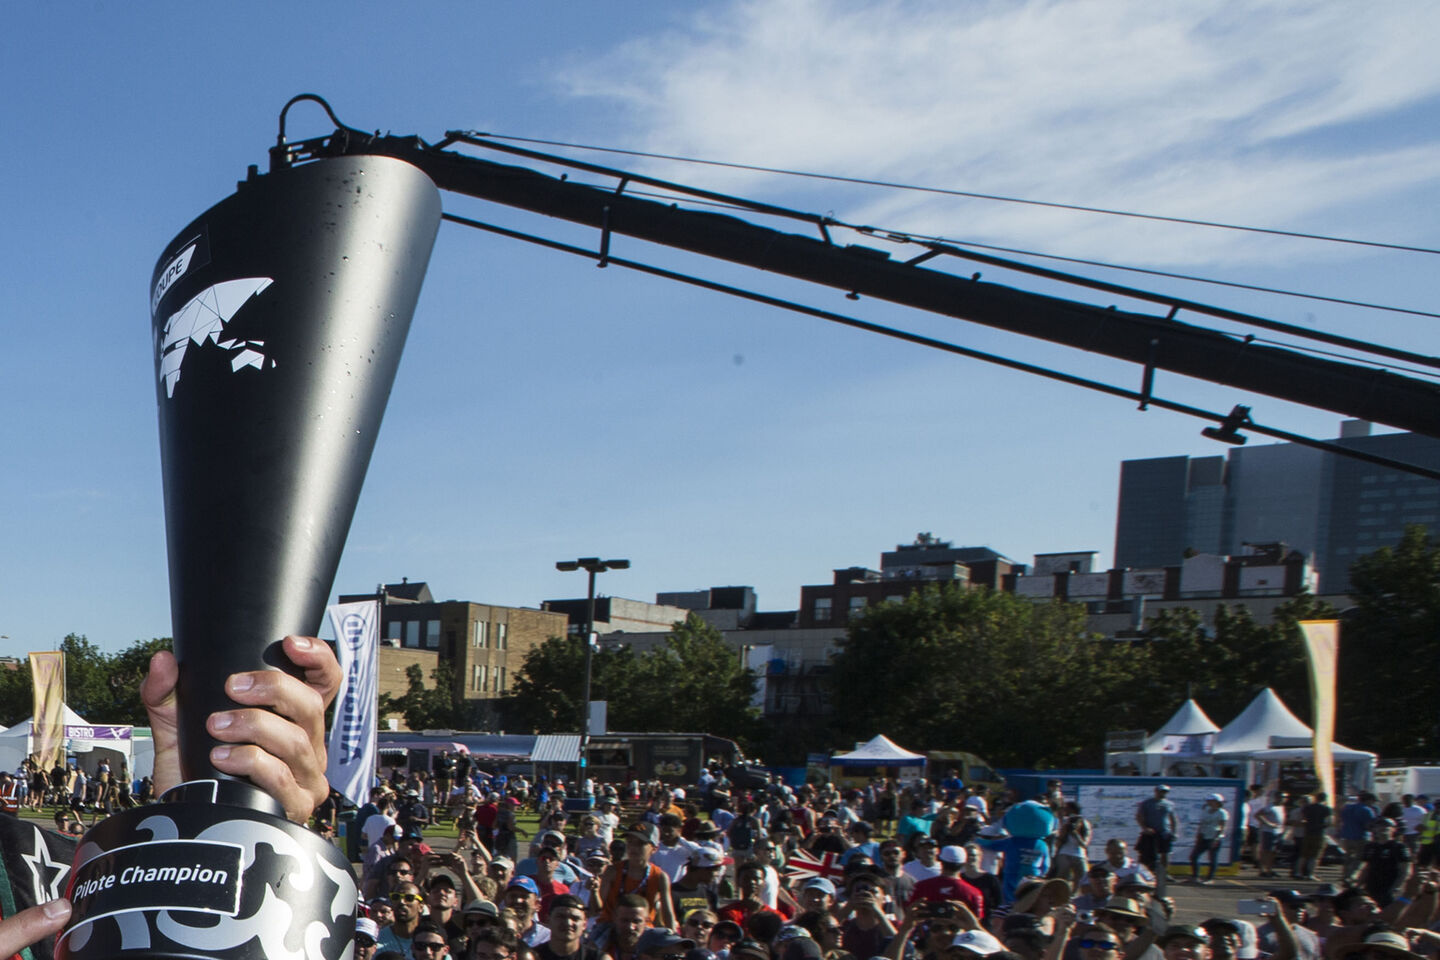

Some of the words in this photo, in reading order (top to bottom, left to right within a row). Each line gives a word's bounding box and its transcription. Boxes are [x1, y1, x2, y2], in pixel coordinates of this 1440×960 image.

[68, 726, 95, 738] BISTRO
[73, 873, 116, 903] Pilote
[120, 864, 229, 886] Champion
